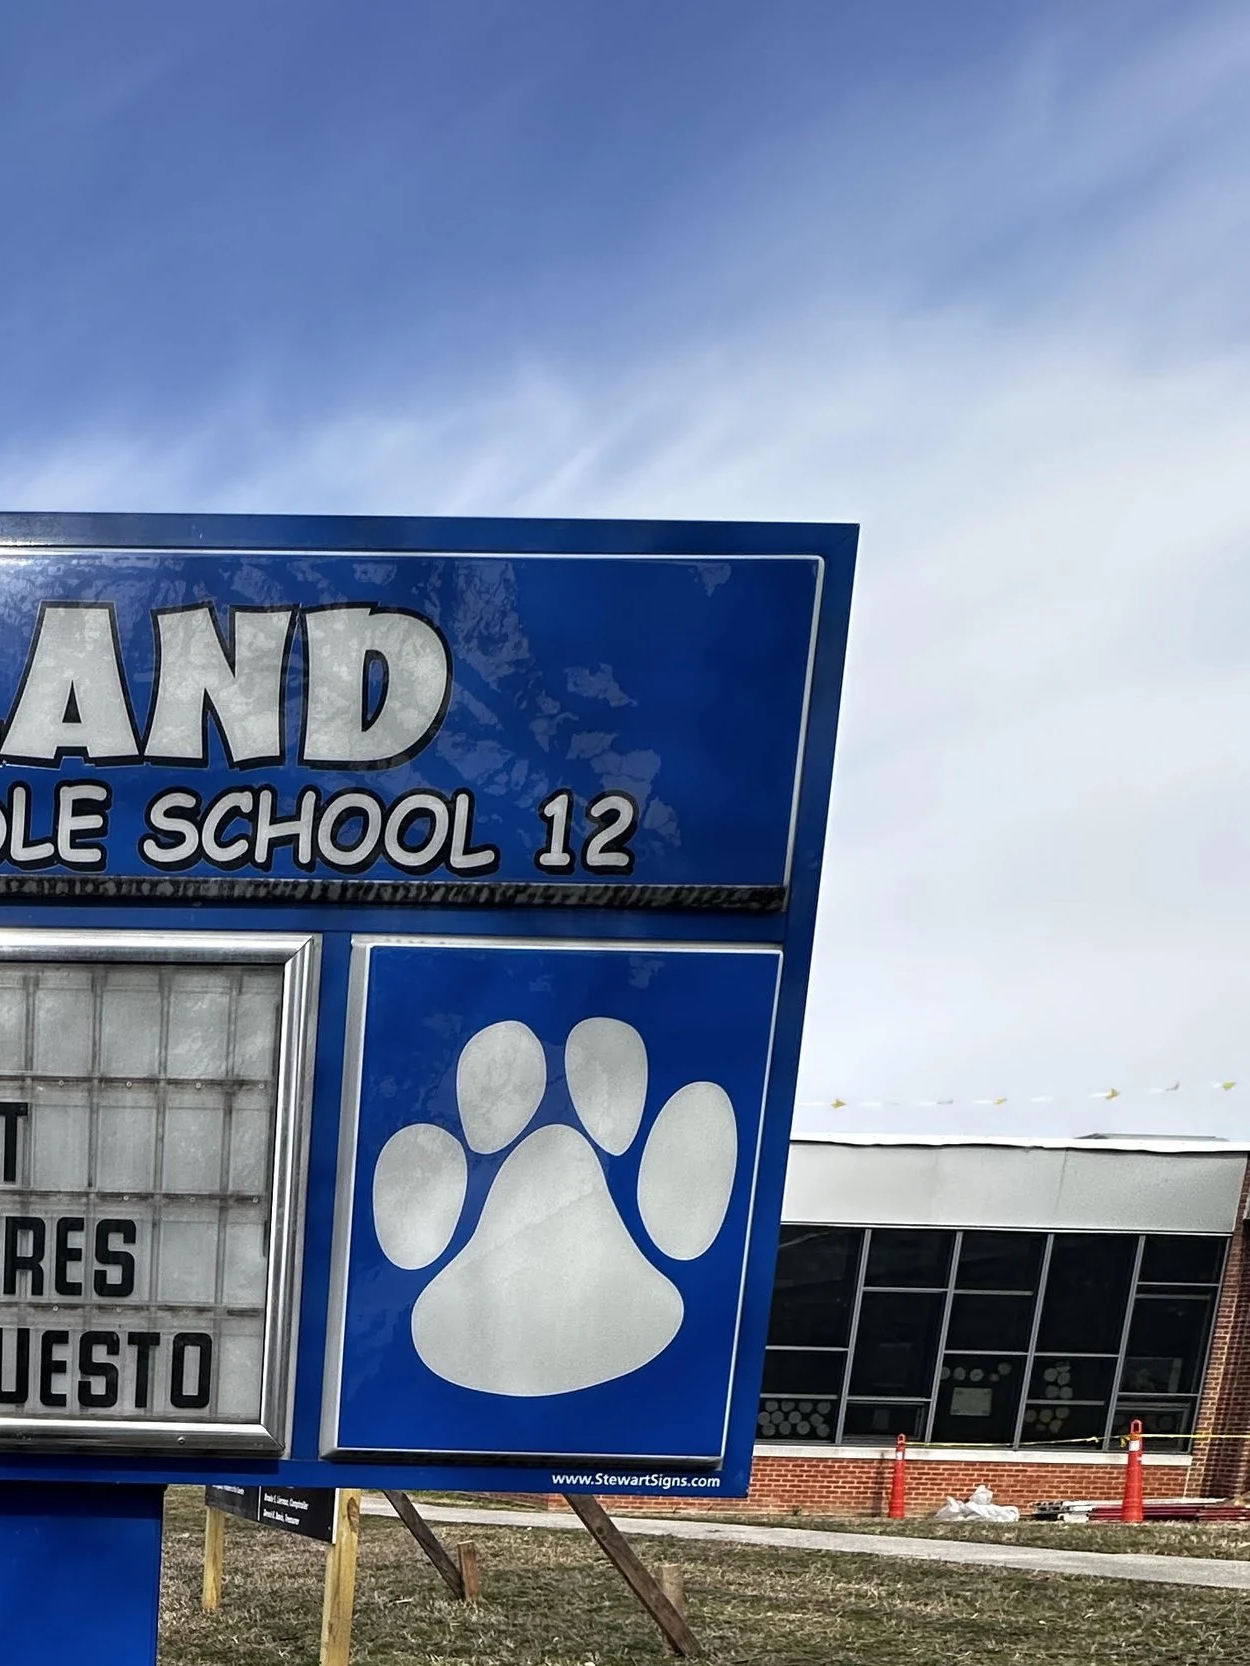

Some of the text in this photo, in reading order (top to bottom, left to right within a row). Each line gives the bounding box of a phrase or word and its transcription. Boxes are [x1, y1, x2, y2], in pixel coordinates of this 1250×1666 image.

[141, 786, 498, 872] SCHOOL
[536, 790, 638, 872] 12
[552, 1472, 721, 1490] www.StewartSigns.com
